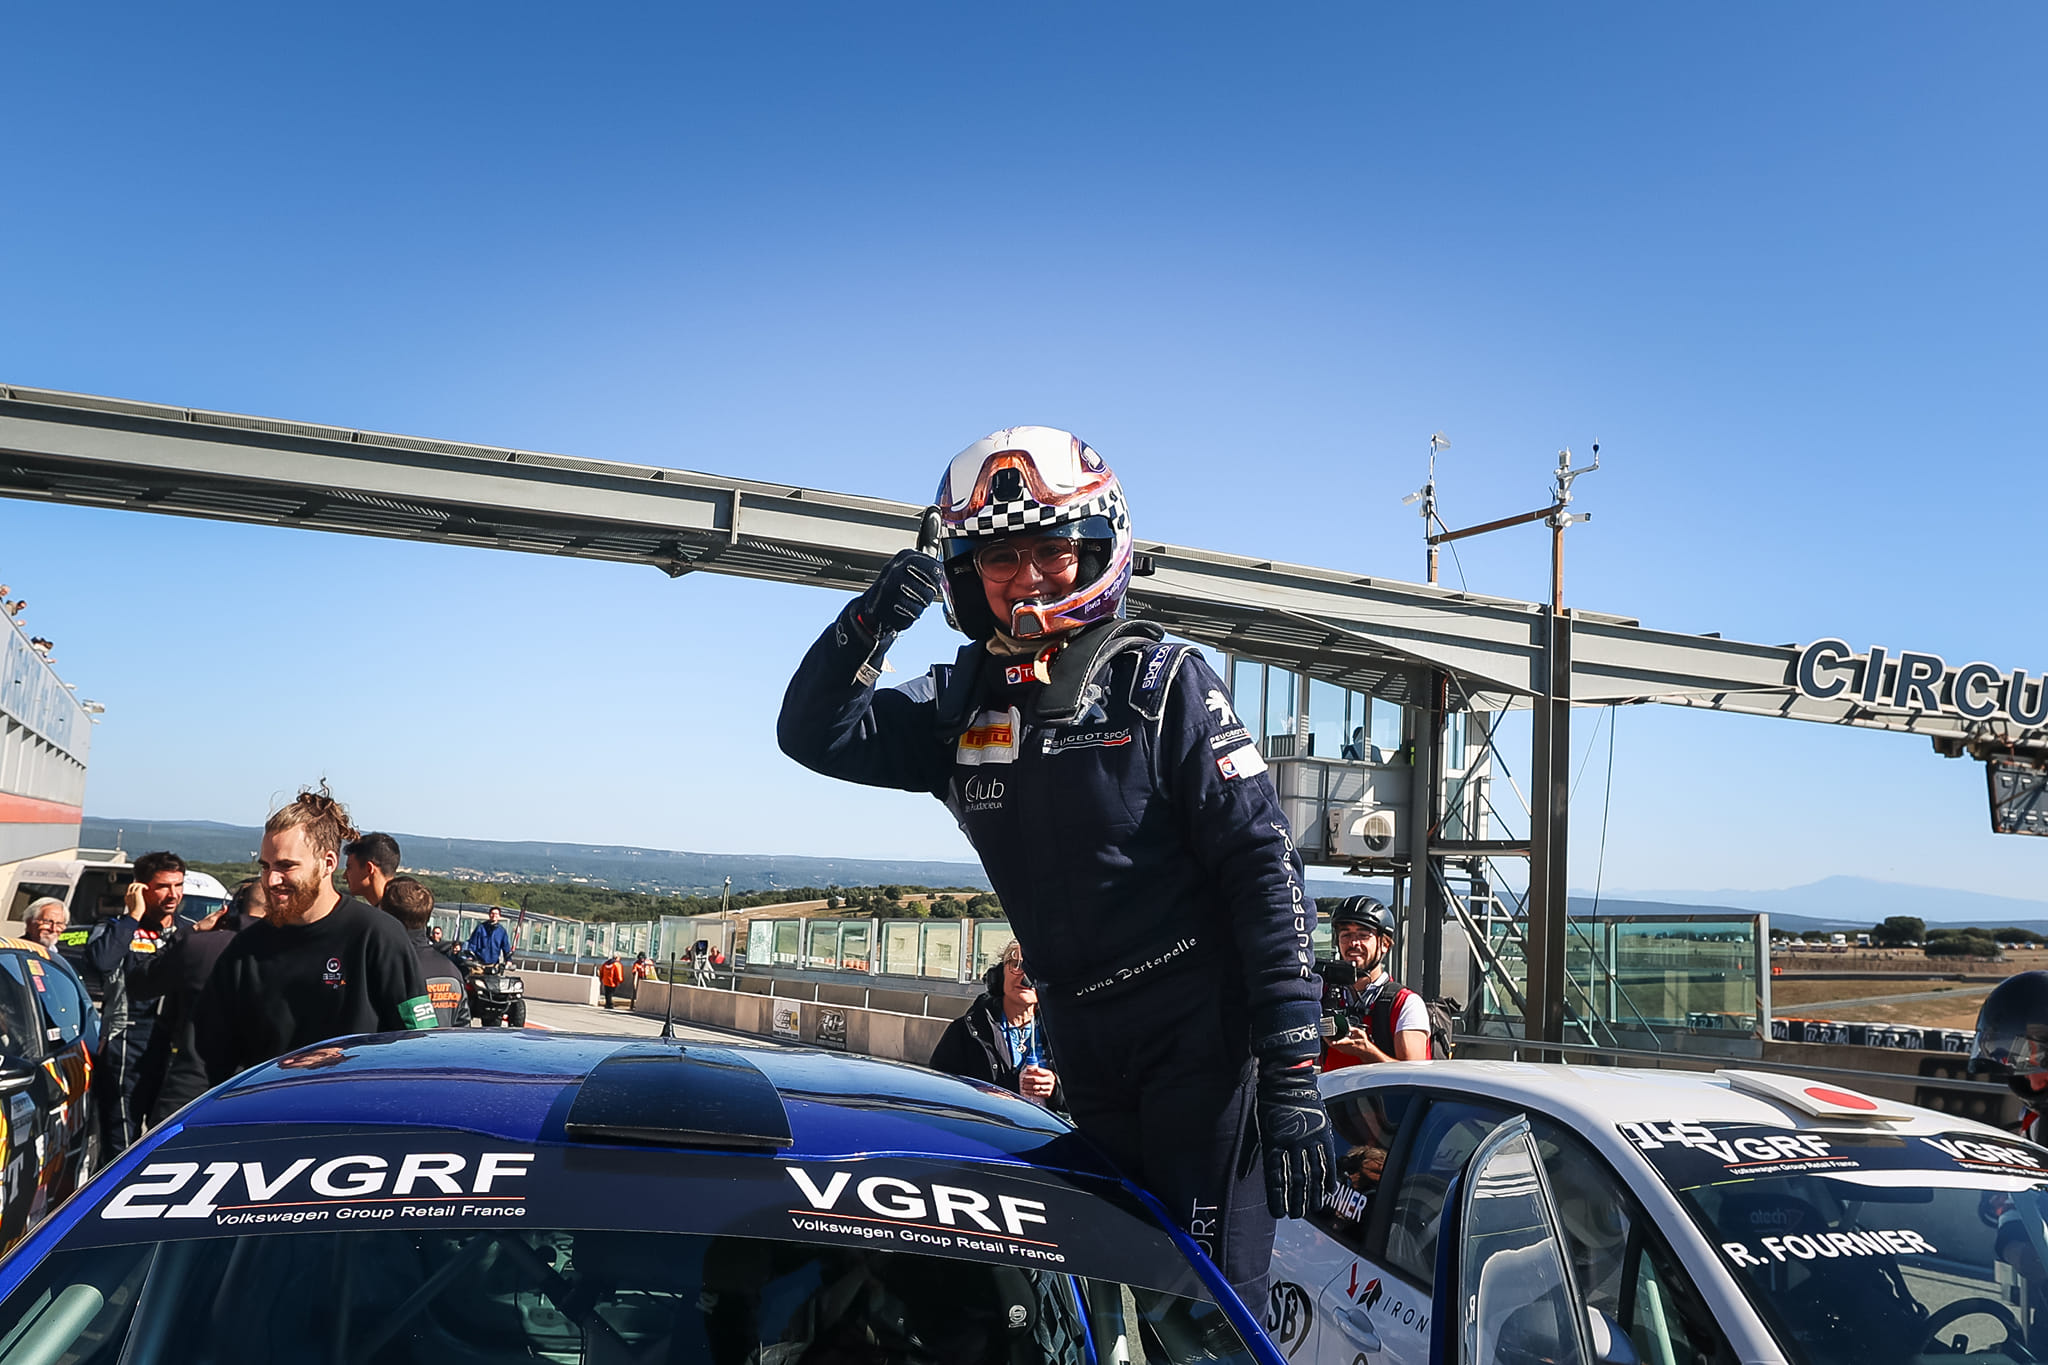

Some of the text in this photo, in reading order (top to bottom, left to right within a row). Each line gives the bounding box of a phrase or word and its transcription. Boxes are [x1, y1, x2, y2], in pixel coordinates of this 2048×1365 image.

[1797, 638, 2048, 728] CIRCU
[1044, 732, 1102, 748] PEUGEOT
[965, 774, 1005, 803] Club
[1621, 1119, 1718, 1150] 145
[1695, 1135, 1831, 1164] VGRF
[1919, 1137, 2040, 1168] VGRF
[101, 1161, 239, 1219] 21
[239, 1153, 535, 1202] VGRF
[215, 1204, 526, 1225] Volkswagen Group Retail France
[786, 1167, 1047, 1236] VGRF
[791, 1216, 1066, 1264] Volkswagen Group Retail France
[1722, 1229, 1938, 1268] R. FOURNIER
[1382, 1299, 1430, 1335] IRON
